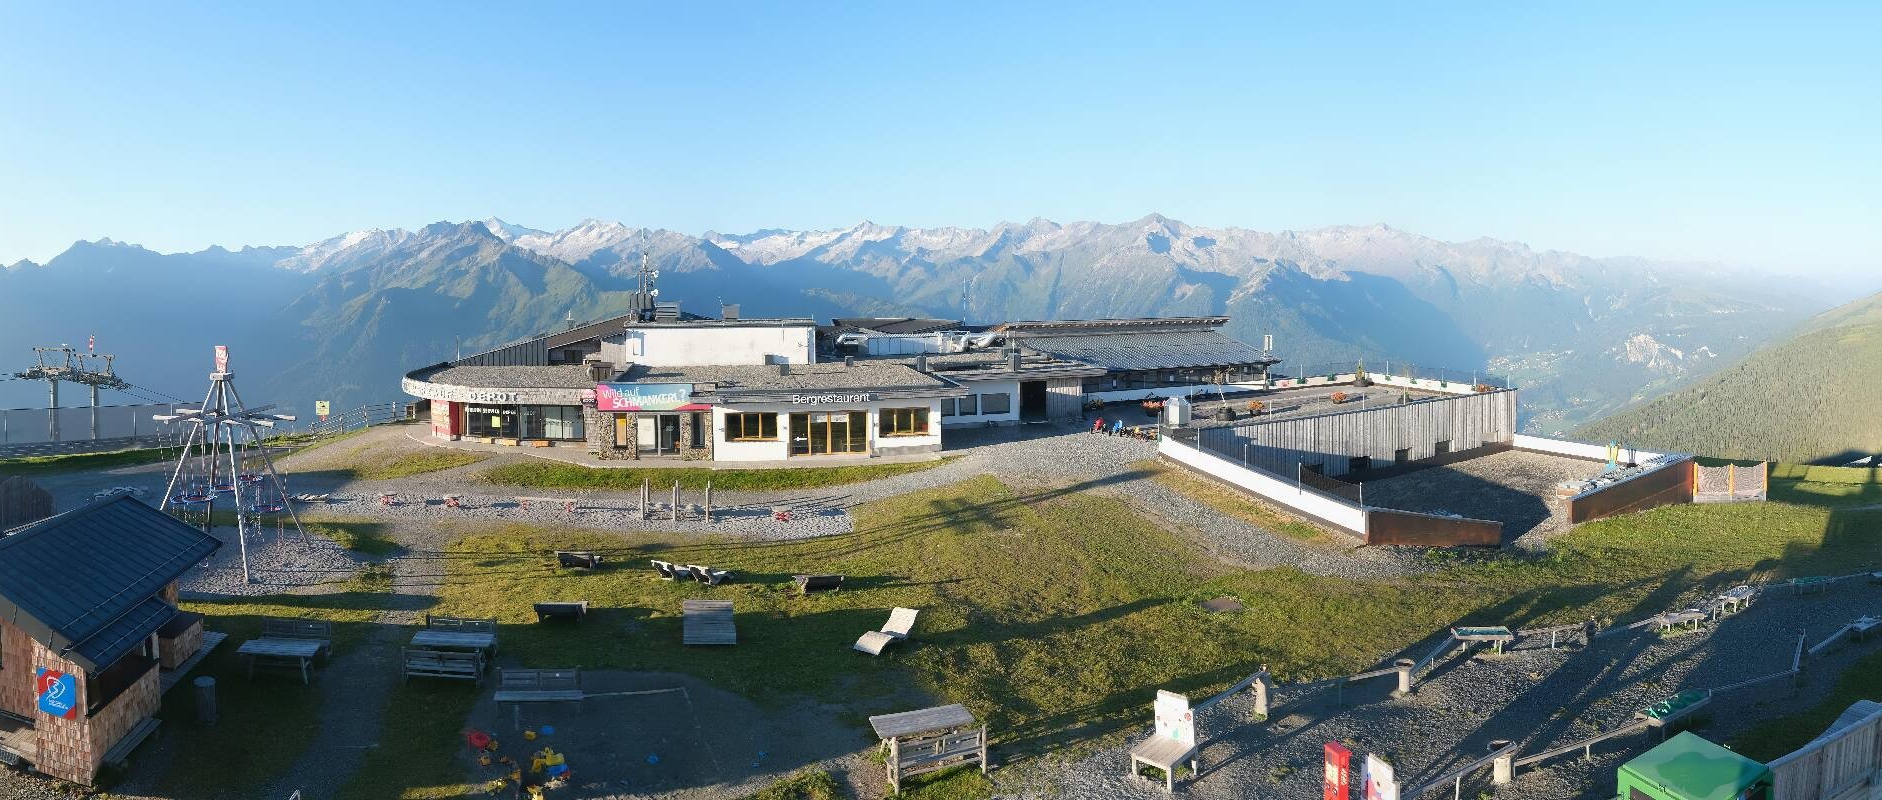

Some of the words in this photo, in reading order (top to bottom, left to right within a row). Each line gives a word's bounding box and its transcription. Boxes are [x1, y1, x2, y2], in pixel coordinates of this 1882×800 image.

[470, 392, 518, 402] DEPOT
[602, 387, 623, 399] Wild
[624, 386, 640, 397] auf
[792, 392, 870, 405] Bergrestaurant
